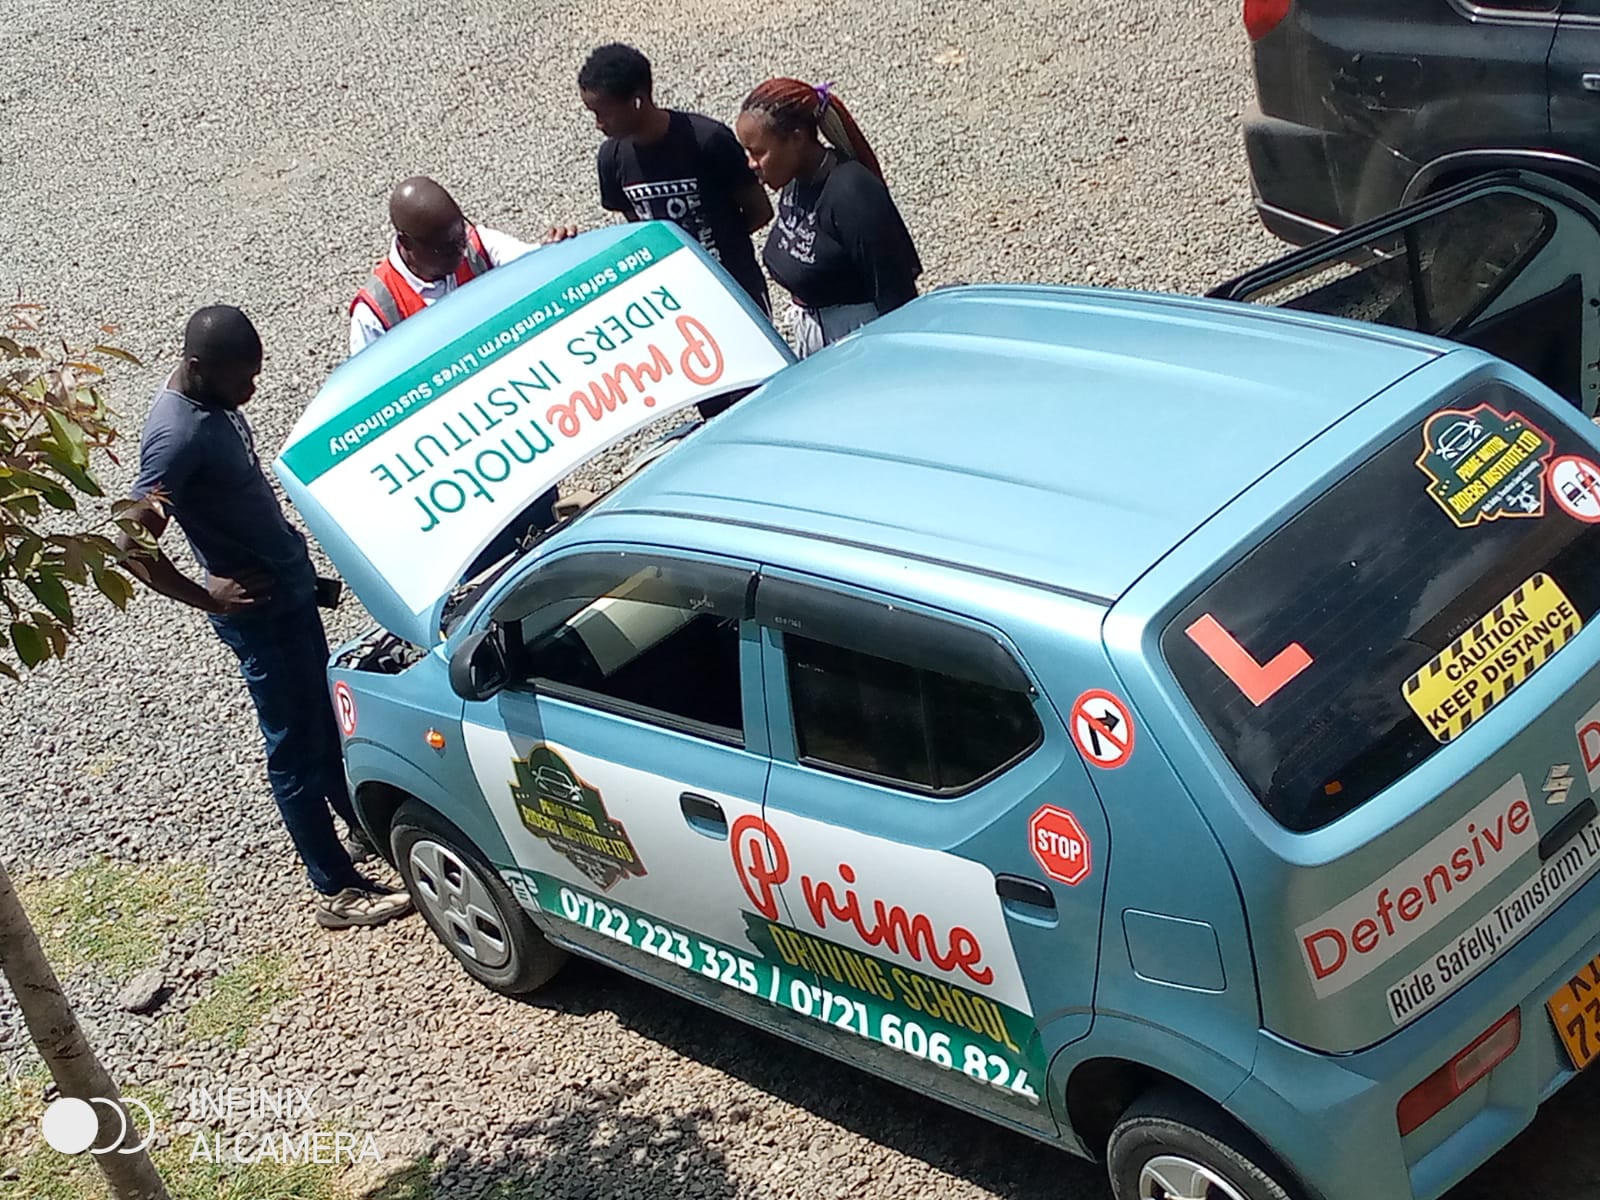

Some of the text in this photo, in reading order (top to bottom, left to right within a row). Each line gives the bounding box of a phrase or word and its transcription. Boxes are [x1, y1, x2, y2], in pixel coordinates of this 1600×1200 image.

[329, 247, 653, 455] Ride Safely, Transform Lives Sustainably
[370, 285, 682, 495] RIDERS INSTITUTE
[414, 315, 724, 532] Prime motor
[1447, 479, 1488, 515] RIDERS
[1480, 443, 1529, 488] INSTITUTE
[1516, 430, 1542, 453] LTD
[1185, 613, 1313, 706] L
[1426, 601, 1574, 729] KEEP DISTANCE
[1445, 607, 1529, 681] CAUTION
[731, 814, 994, 986] Prime
[1037, 829, 1081, 861] STOP
[1302, 799, 1531, 981] Defensive
[560, 887, 633, 945] 0722
[636, 917, 693, 969] 223
[699, 942, 759, 995] 325
[790, 979, 869, 1038] 0721
[880, 1013, 953, 1071] 606
[767, 923, 1020, 1054] DRIVING SCHOOL
[1389, 972, 1436, 1018] Ride
